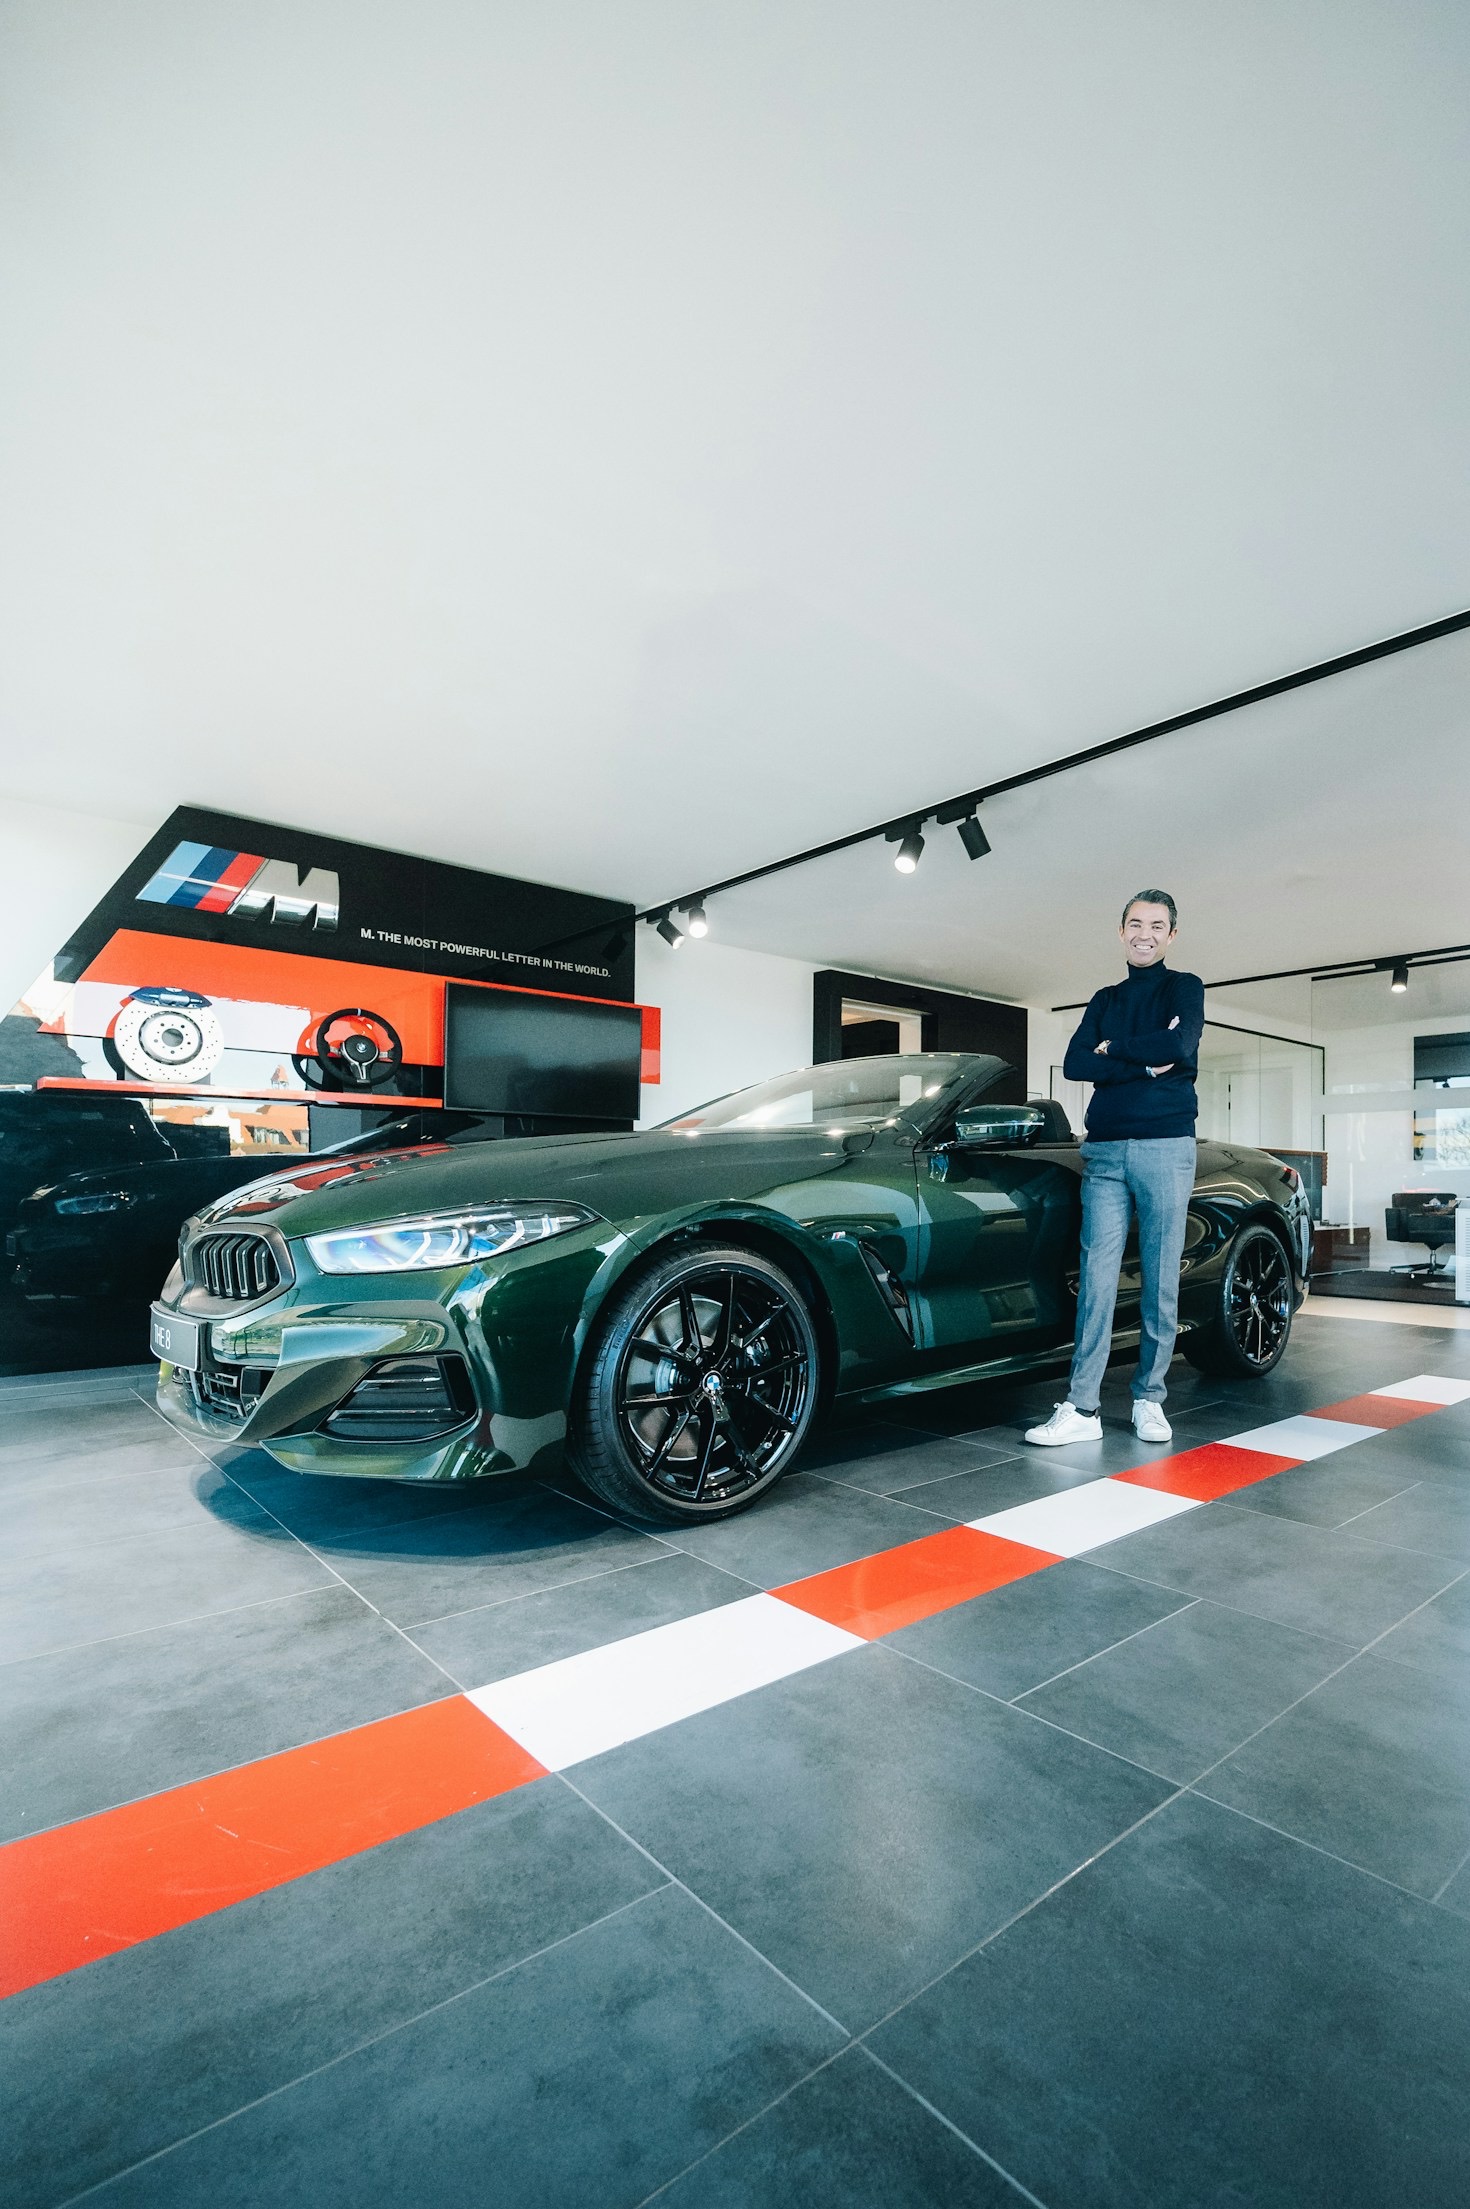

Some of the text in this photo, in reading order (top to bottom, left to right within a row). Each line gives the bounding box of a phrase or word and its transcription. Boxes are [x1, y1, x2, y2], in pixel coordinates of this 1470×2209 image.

[227, 858, 340, 933] M
[360, 927, 612, 978] M. THE MOST POWERFUL LETTER IN THE WORLD.
[153, 1323, 171, 1350] THE 8
